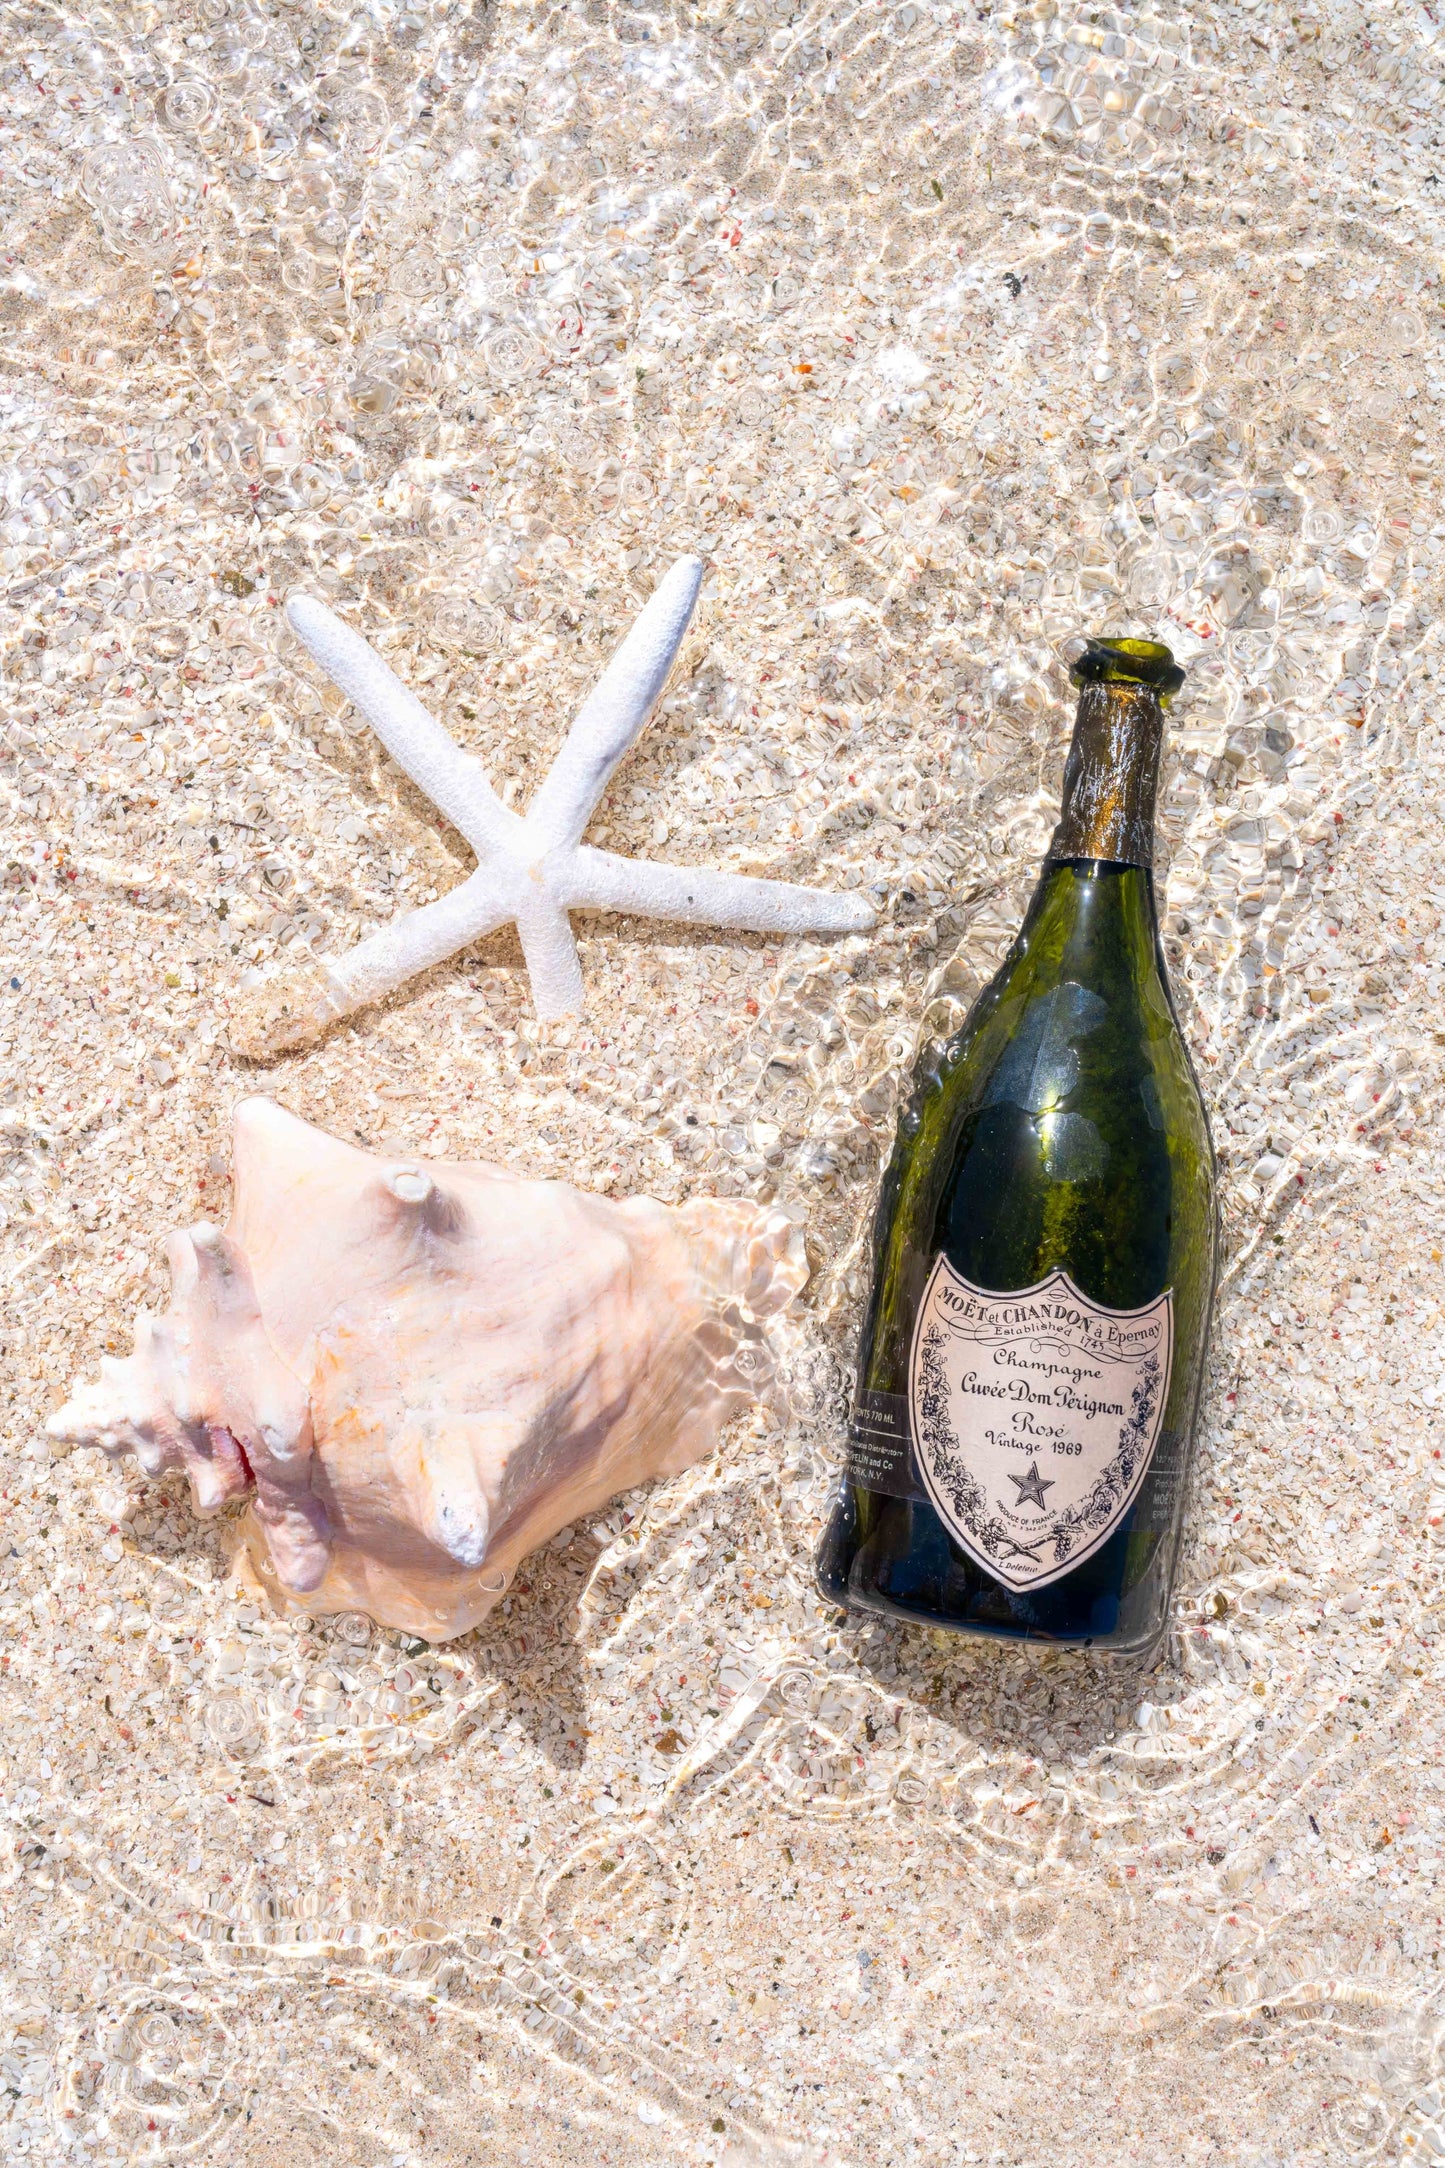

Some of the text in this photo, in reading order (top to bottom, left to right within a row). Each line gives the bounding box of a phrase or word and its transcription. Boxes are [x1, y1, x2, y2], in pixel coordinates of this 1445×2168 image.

[937, 1286, 988, 1321] MOËT
[988, 1311, 999, 1323] et
[1002, 1304, 1095, 1333] CHANDON
[1108, 1322, 1161, 1346] Epernay
[994, 1321, 1072, 1337] Established
[993, 1348, 1103, 1384] Champagne
[961, 1371, 1125, 1420] Cuvée Dom Pérignon
[883, 1413, 895, 1424] ML
[1011, 1411, 1069, 1438] Rosé
[985, 1430, 1083, 1456] Vintage 1969
[869, 1458, 881, 1467] and
[996, 1500, 1019, 1523] PRODUCE
[1032, 1509, 1058, 1525] FRANCE
